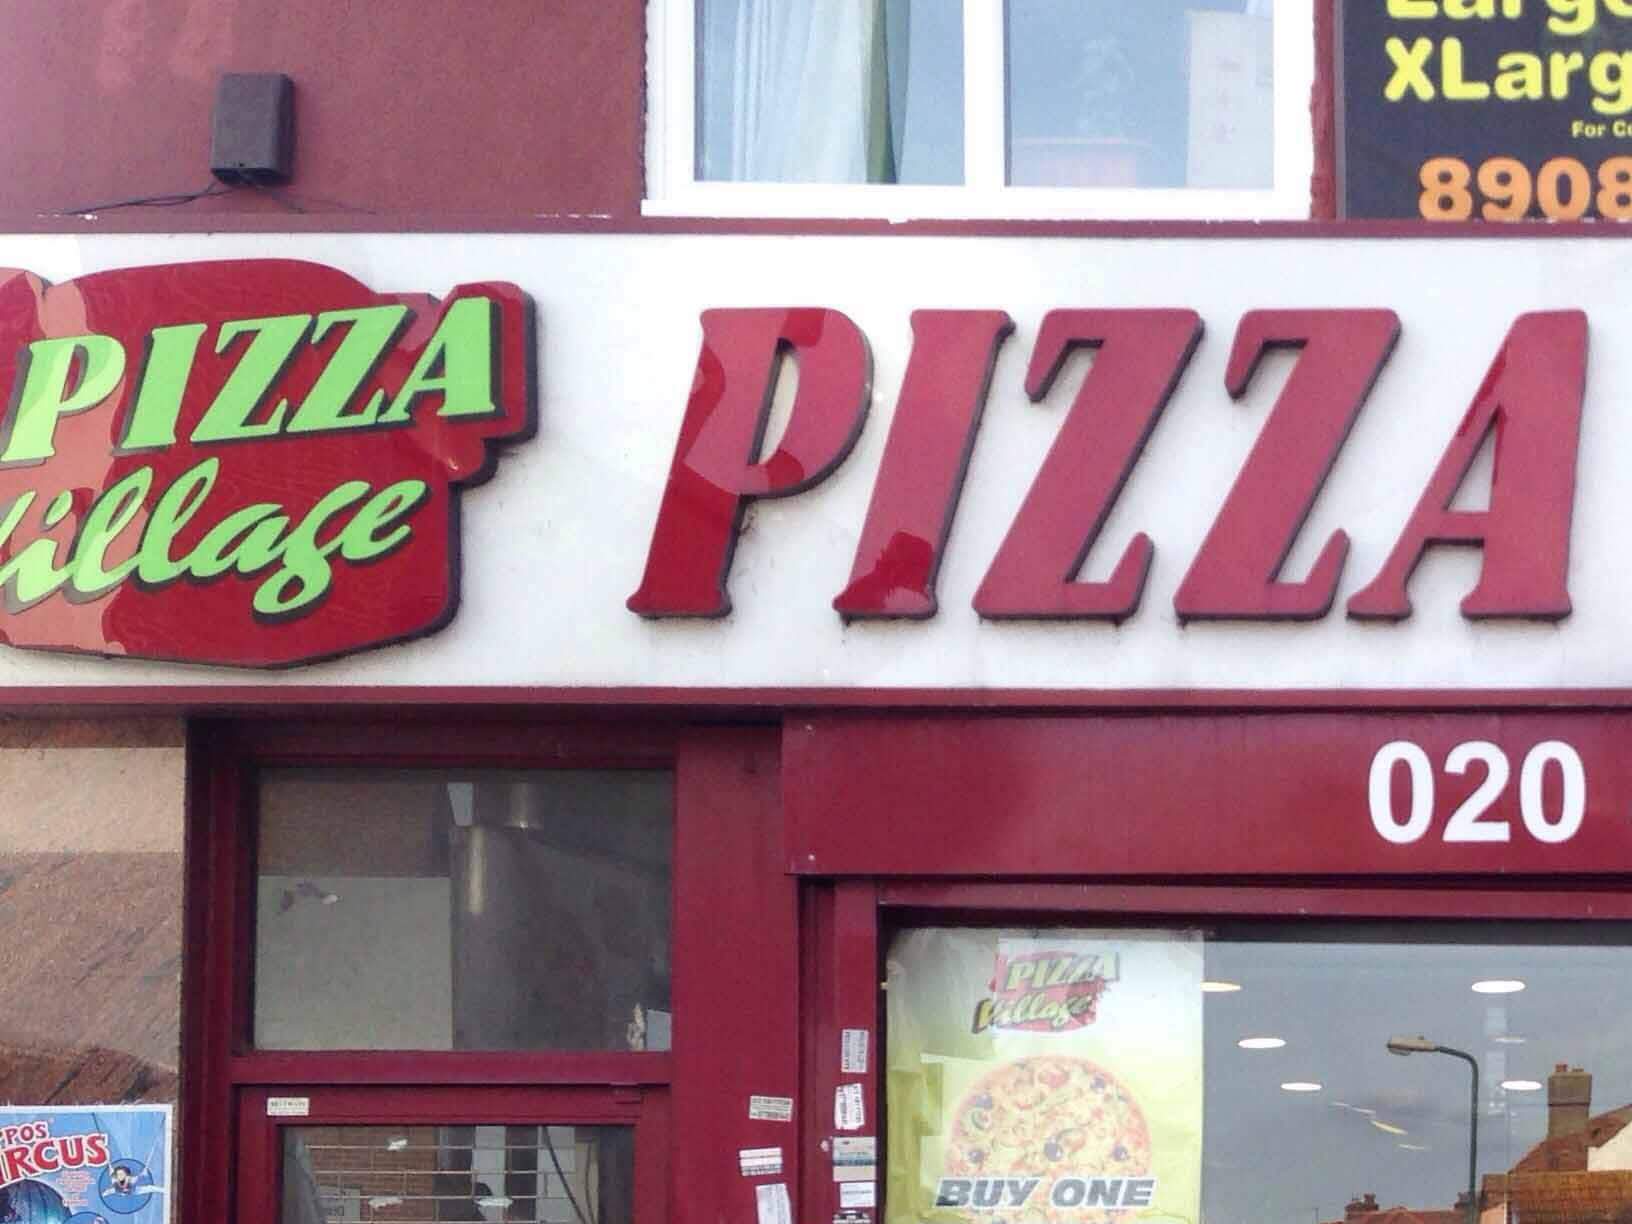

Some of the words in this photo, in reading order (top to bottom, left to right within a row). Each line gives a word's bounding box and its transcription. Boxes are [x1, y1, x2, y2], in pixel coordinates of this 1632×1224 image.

[1571, 119, 1607, 138] For
[0, 295, 498, 466] PIZZA
[626, 306, 1594, 621] PIZZA
[1367, 738, 1588, 845] 020
[1006, 950, 1120, 992] PIZZA
[0, 1121, 49, 1146] POS
[936, 1177, 1041, 1208] BUY
[1050, 1177, 1156, 1208] ONE
